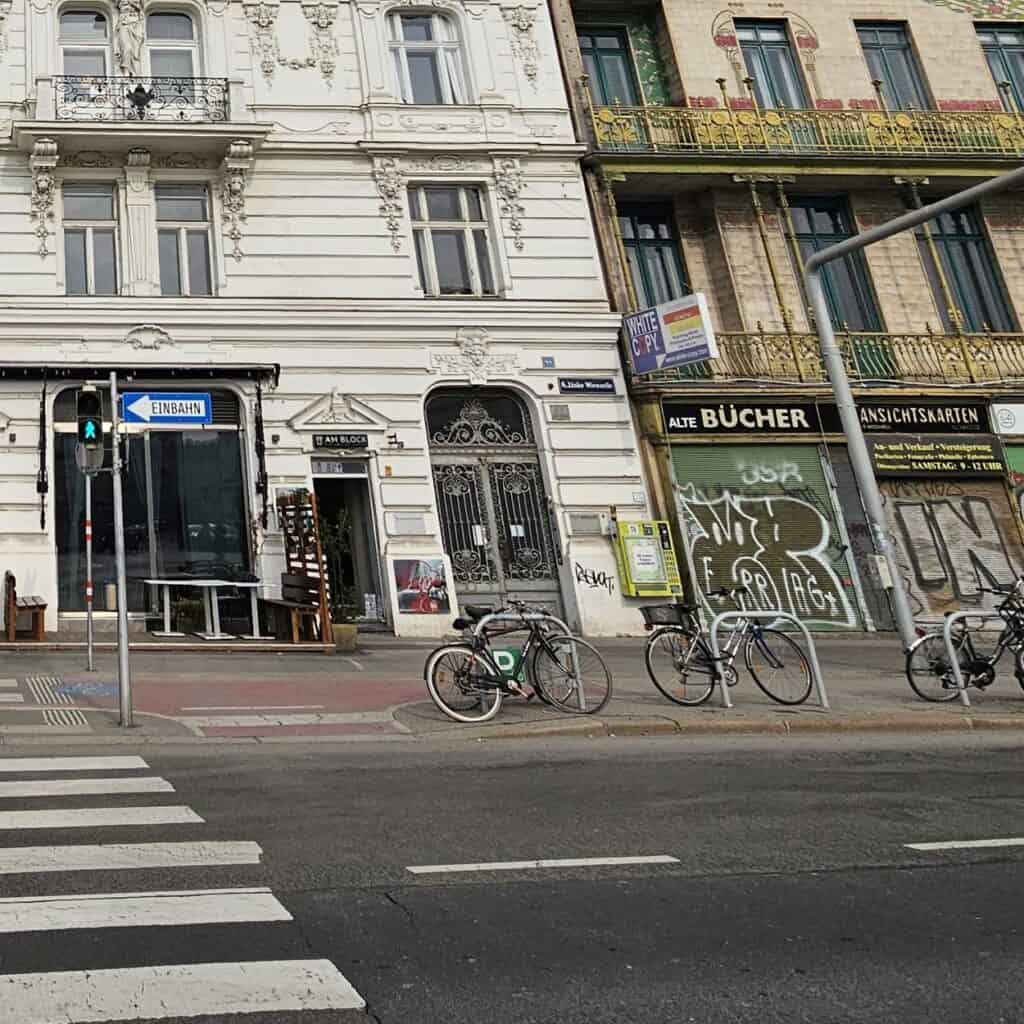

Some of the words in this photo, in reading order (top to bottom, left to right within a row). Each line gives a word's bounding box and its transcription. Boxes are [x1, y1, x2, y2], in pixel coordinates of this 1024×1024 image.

[626, 311, 658, 338] WHITE
[151, 401, 201, 415] EINBAHN
[668, 417, 697, 429] ALTE
[700, 404, 810, 428] BÜCHER
[860, 407, 979, 424] ANSICHTSKARTEN
